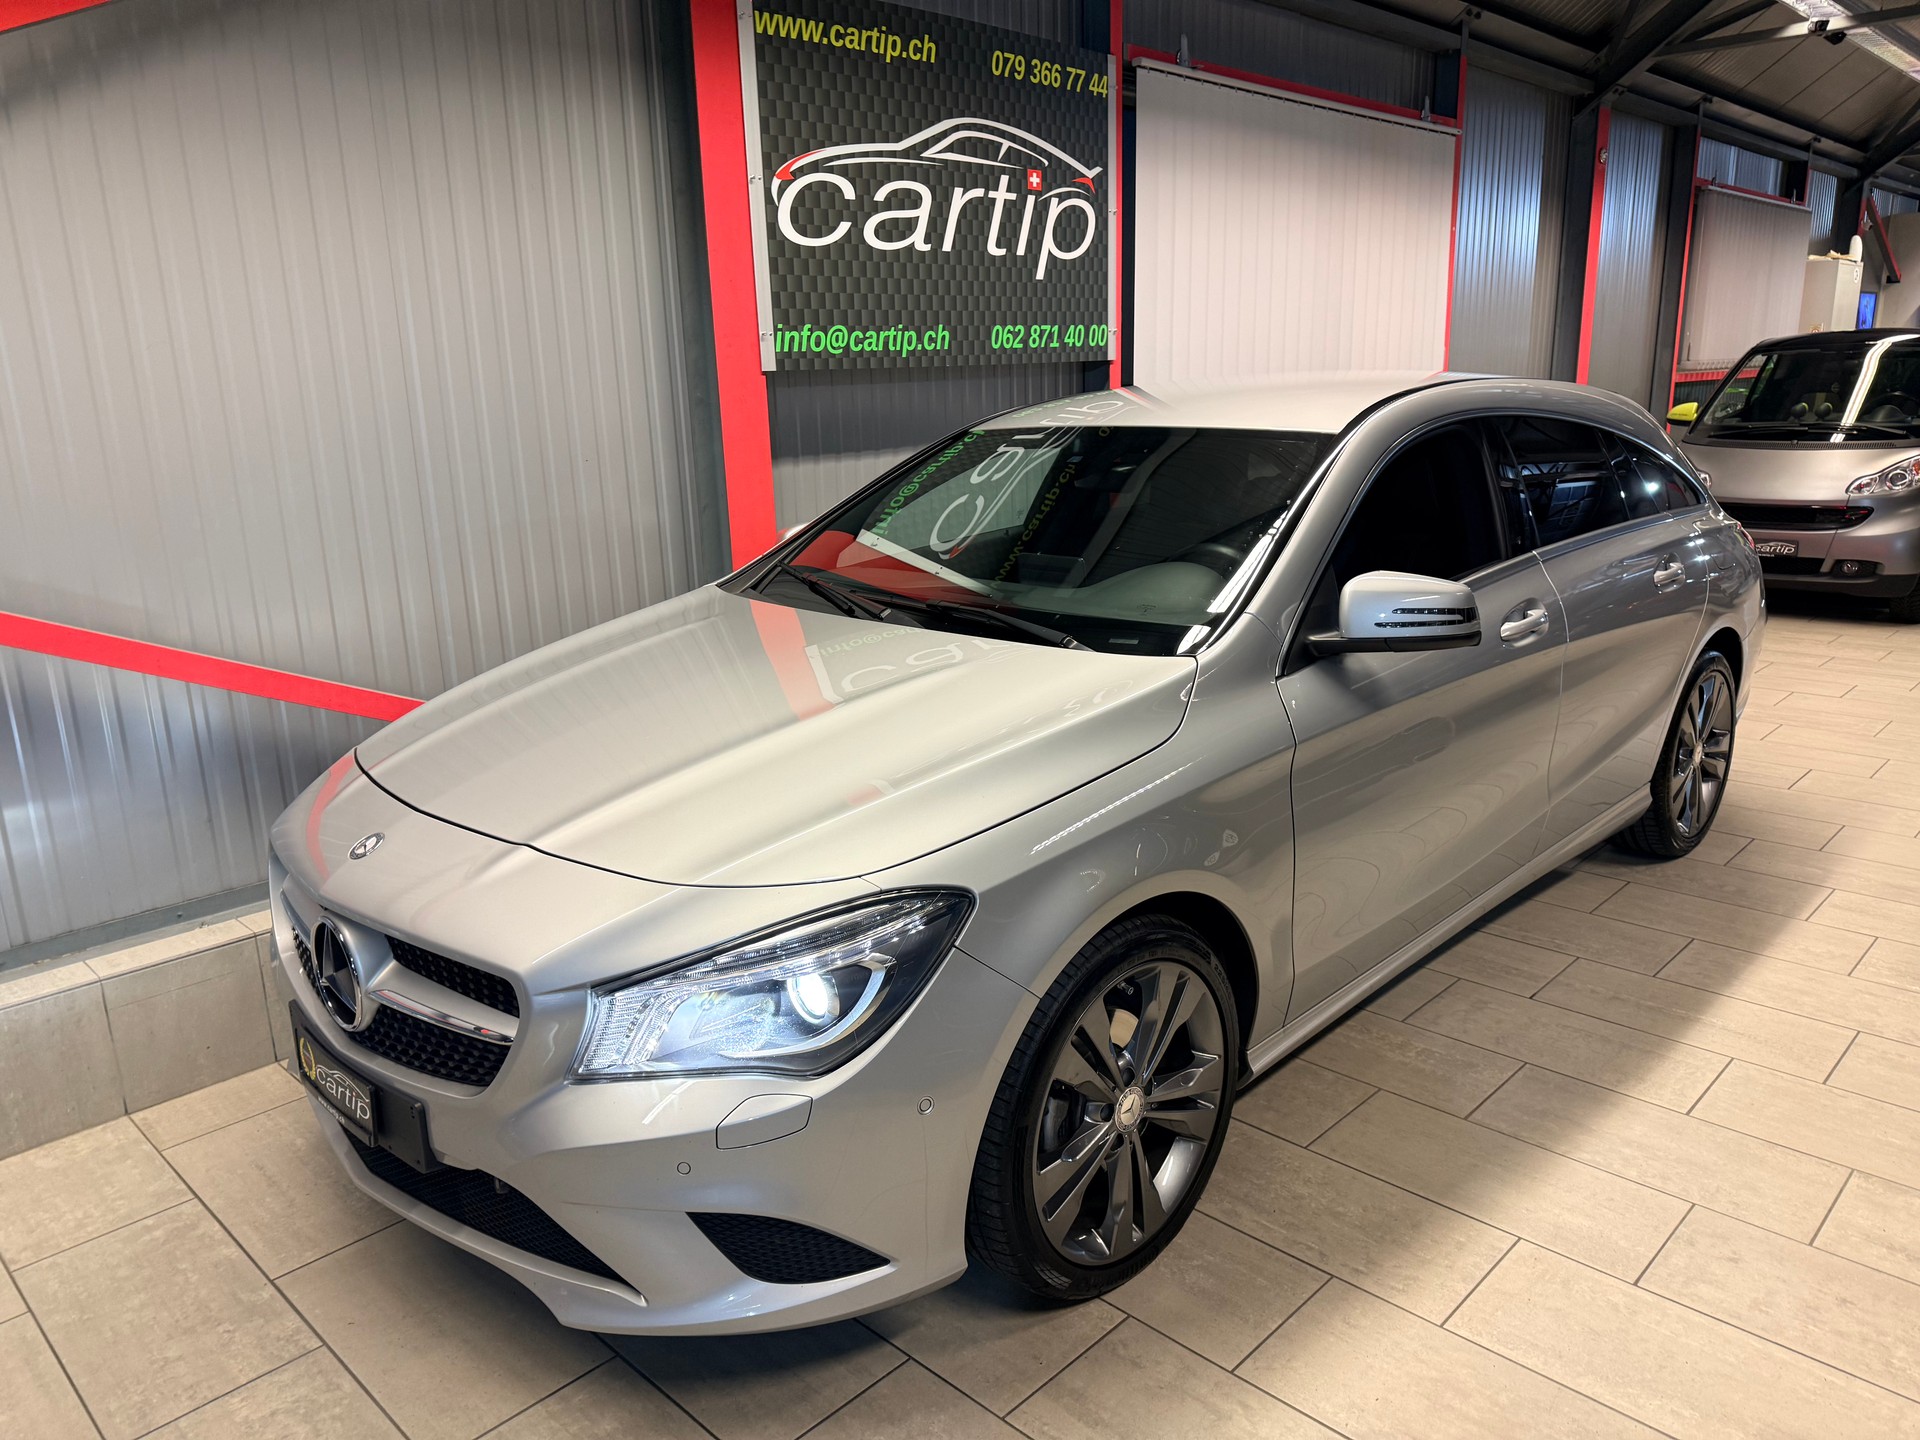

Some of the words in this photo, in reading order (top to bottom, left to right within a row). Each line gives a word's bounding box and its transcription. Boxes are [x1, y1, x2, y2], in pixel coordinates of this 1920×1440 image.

[754, 10, 937, 63] www.cartip.ch
[991, 50, 1026, 81] 079
[1030, 60, 1061, 88] 366
[1066, 67, 1086, 93] 77
[1089, 75, 1108, 98] 44
[776, 170, 1097, 281] cartip
[775, 323, 950, 357] info@cartip.ch
[991, 324, 1025, 350] 062
[1029, 324, 1060, 349] 871
[1064, 324, 1085, 348] 40
[1088, 324, 1109, 347] 00
[316, 1067, 370, 1120] cartip
